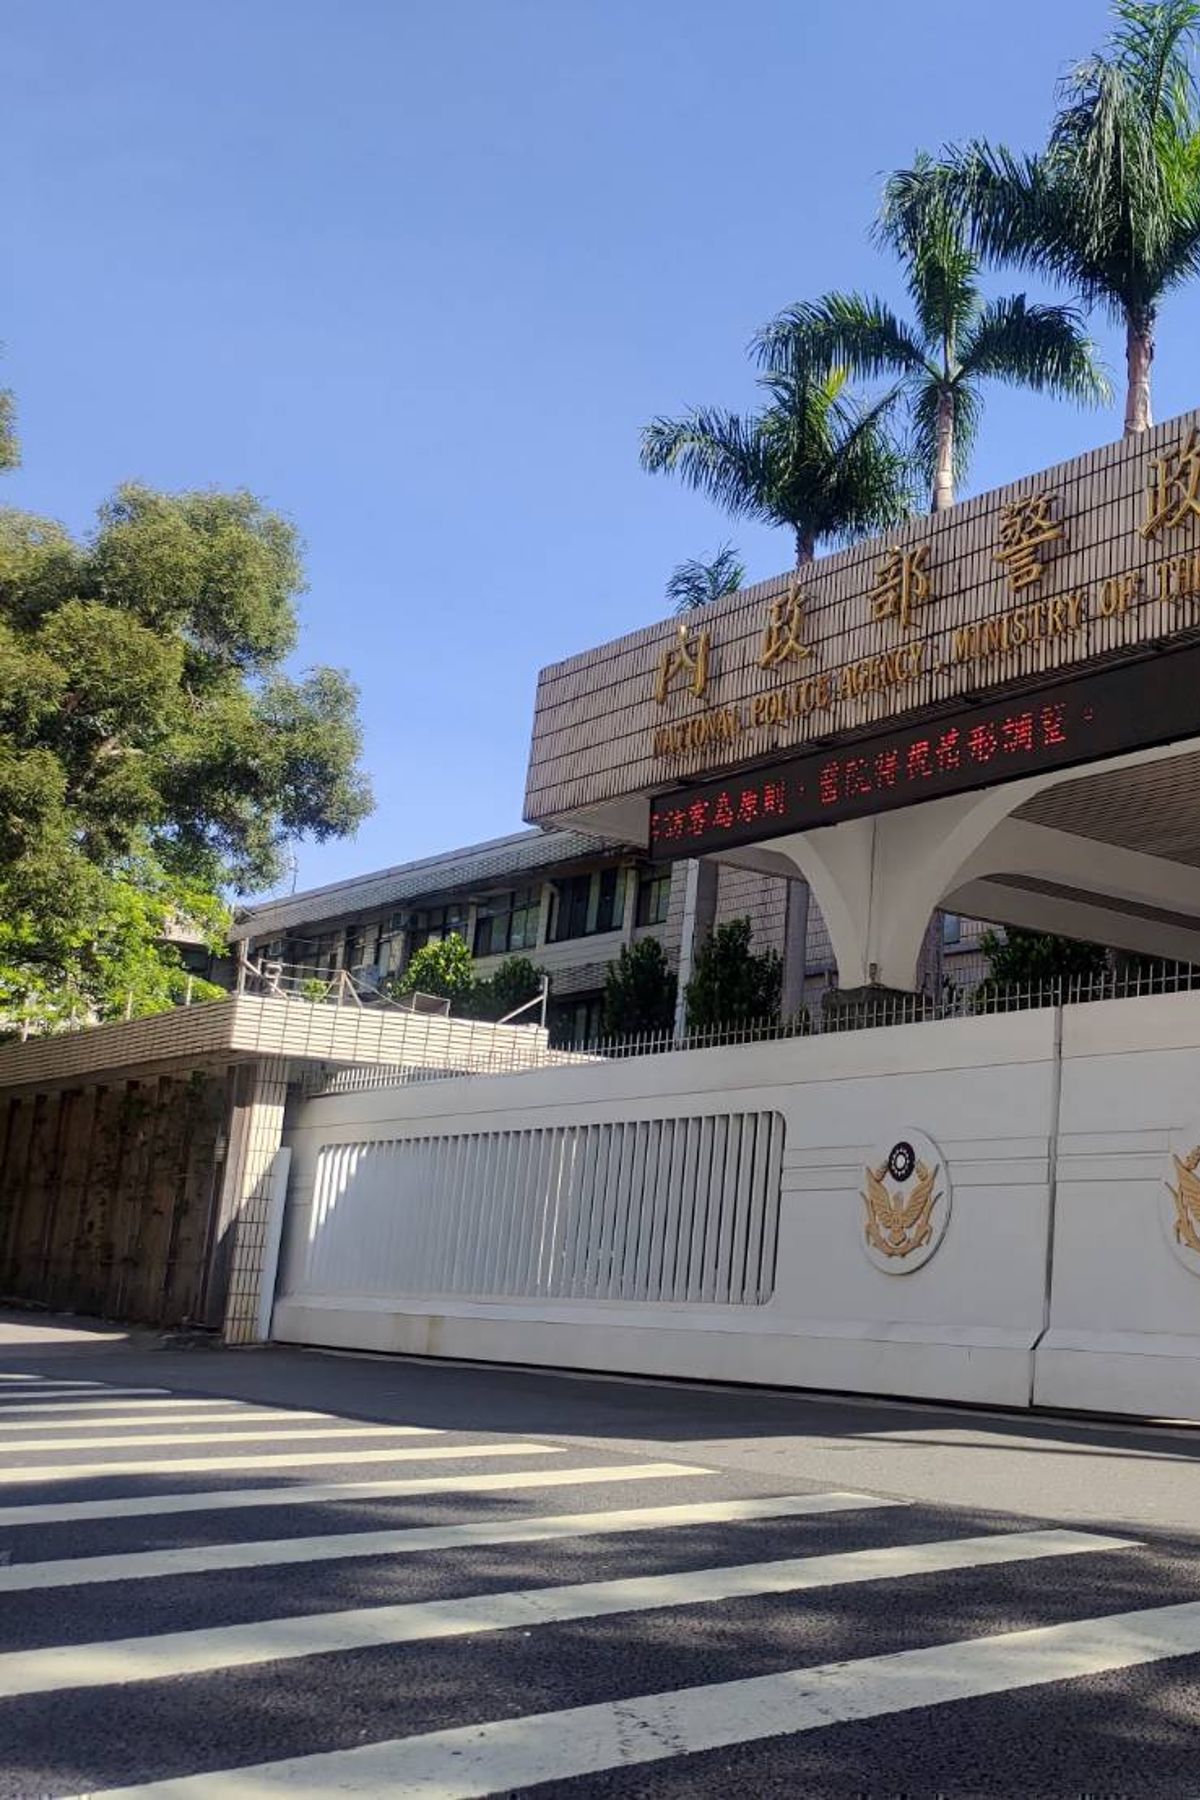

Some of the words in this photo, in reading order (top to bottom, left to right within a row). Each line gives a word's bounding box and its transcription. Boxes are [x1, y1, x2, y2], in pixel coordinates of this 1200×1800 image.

[653, 706, 741, 757] NATIONAL
[752, 673, 832, 728] POLICE
[954, 591, 1082, 661] MINISTRY
[1100, 571, 1139, 617] OF
